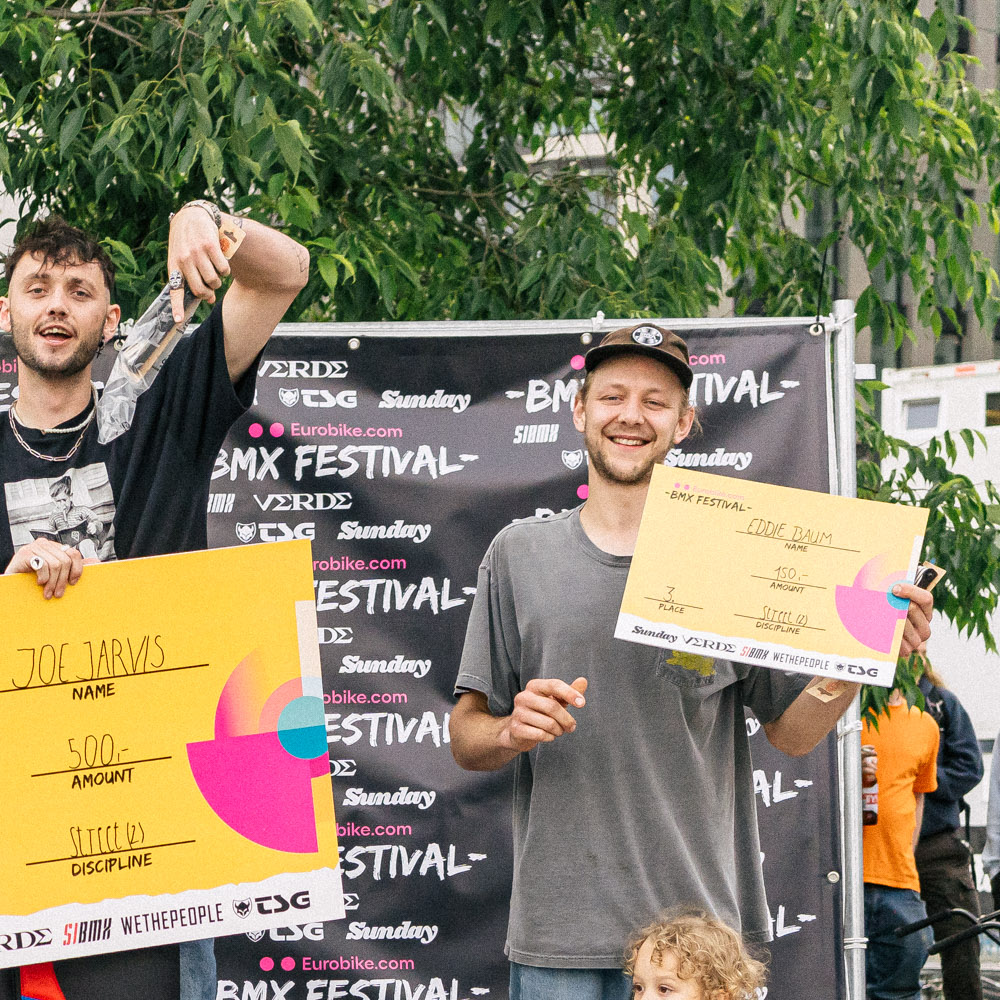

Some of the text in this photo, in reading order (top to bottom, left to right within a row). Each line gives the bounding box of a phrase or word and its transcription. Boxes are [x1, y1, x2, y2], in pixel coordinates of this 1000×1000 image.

[301, 389, 472, 413] TSG Sunday
[290, 422, 403, 438] Eurobike.com
[211, 446, 285, 481] BMX
[664, 447, 752, 471] Sunday
[258, 520, 432, 544] TSG Sunday
[747, 518, 833, 545] EDDIE BAUM
[784, 542, 808, 553] NAME
[312, 556, 407, 571] robike.com
[770, 582, 805, 594] AMOUNT
[659, 603, 685, 614] PLACE
[756, 622, 801, 635] DISCIPLINE
[12, 635, 165, 689] JOE JARVIS
[632, 625, 678, 644] Sunday
[740, 646, 770, 660] SIBMX
[773, 652, 830, 671] WETHEPEOPLE
[848, 664, 879, 678] TSG
[339, 655, 432, 679] Sunday
[72, 682, 116, 701] NAME
[323, 690, 408, 704] obike.com
[71, 767, 135, 790] AMOUNT
[342, 787, 437, 810] Sunday
[336, 822, 412, 837] bike.com
[71, 852, 153, 877] DISCIPLINE
[63, 918, 112, 946] SIBMX
[120, 903, 224, 936] WETHEPEOPLE
[255, 890, 311, 915] TSG
[346, 921, 438, 944] Sunday
[302, 957, 415, 971] Eurobike.com
